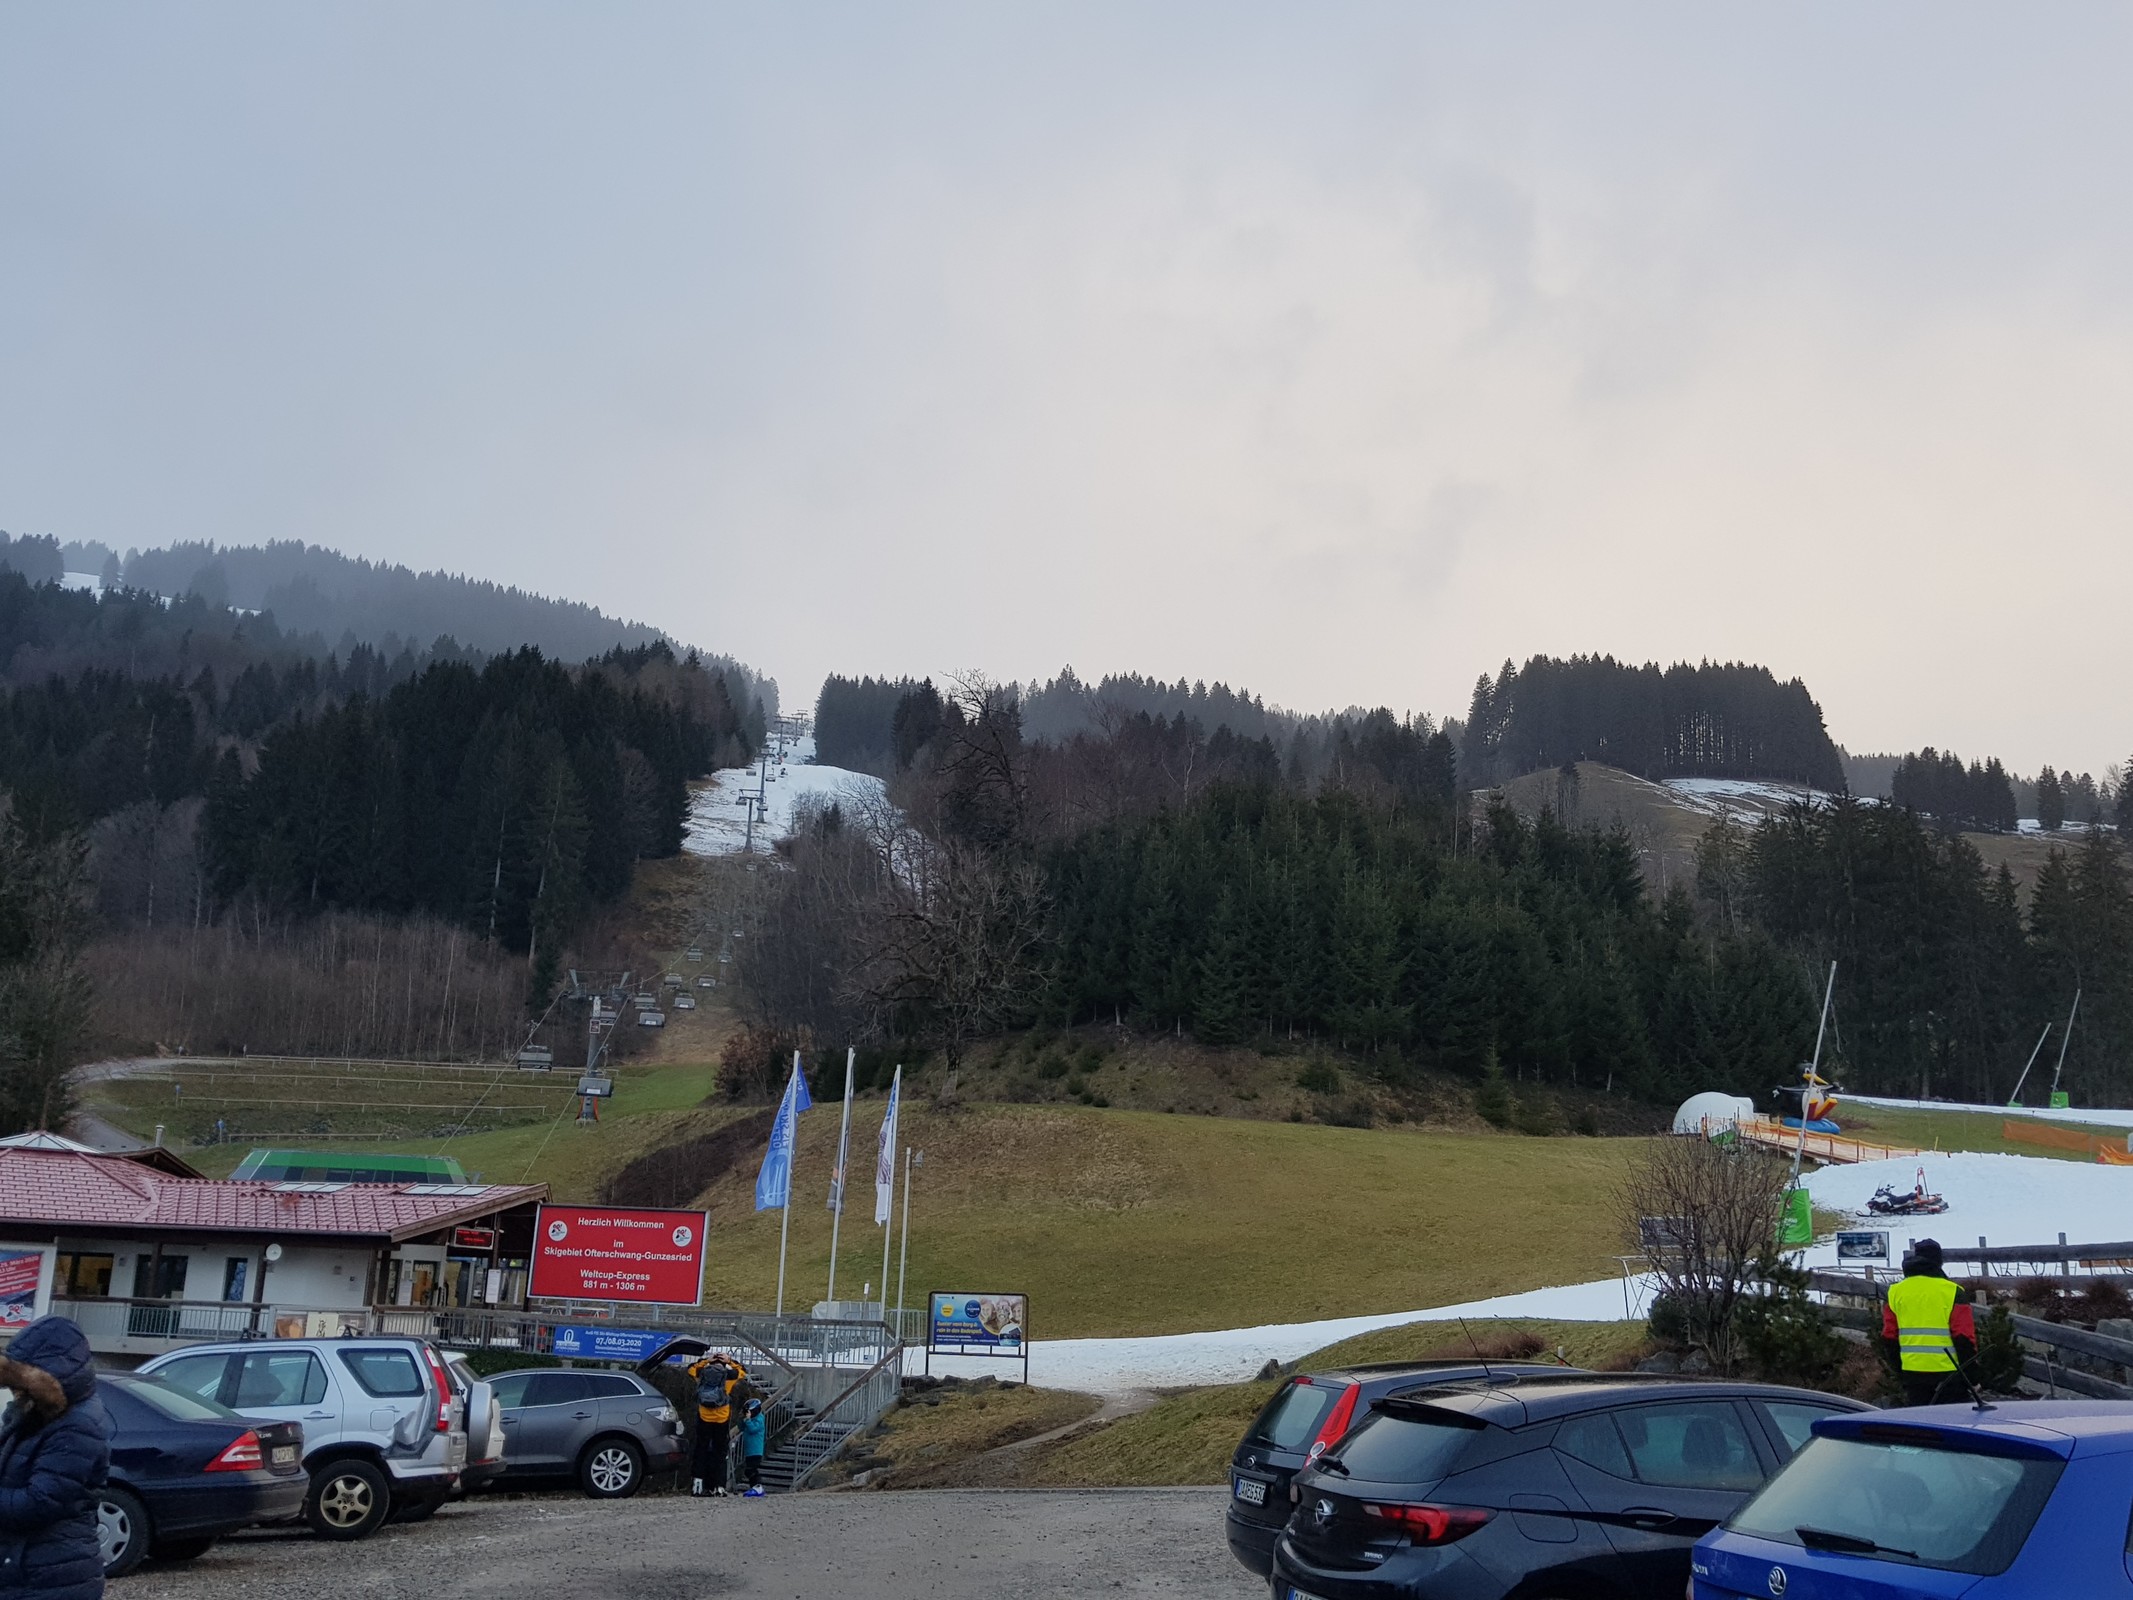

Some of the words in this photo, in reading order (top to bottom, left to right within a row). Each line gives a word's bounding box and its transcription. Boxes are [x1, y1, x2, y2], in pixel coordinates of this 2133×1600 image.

[578, 1217, 611, 1227] Herzlich
[614, 1219, 664, 1229] Willkommen
[613, 1240, 624, 1248] im
[544, 1247, 583, 1258] Skigebiet
[584, 1248, 692, 1262] Ofterschwang-Gunzesried
[580, 1269, 650, 1281] Weltcup-Express
[583, 1280, 597, 1289] 881
[615, 1281, 635, 1290] 1306
[595, 1336, 642, 1347] 07./08.03.2020
